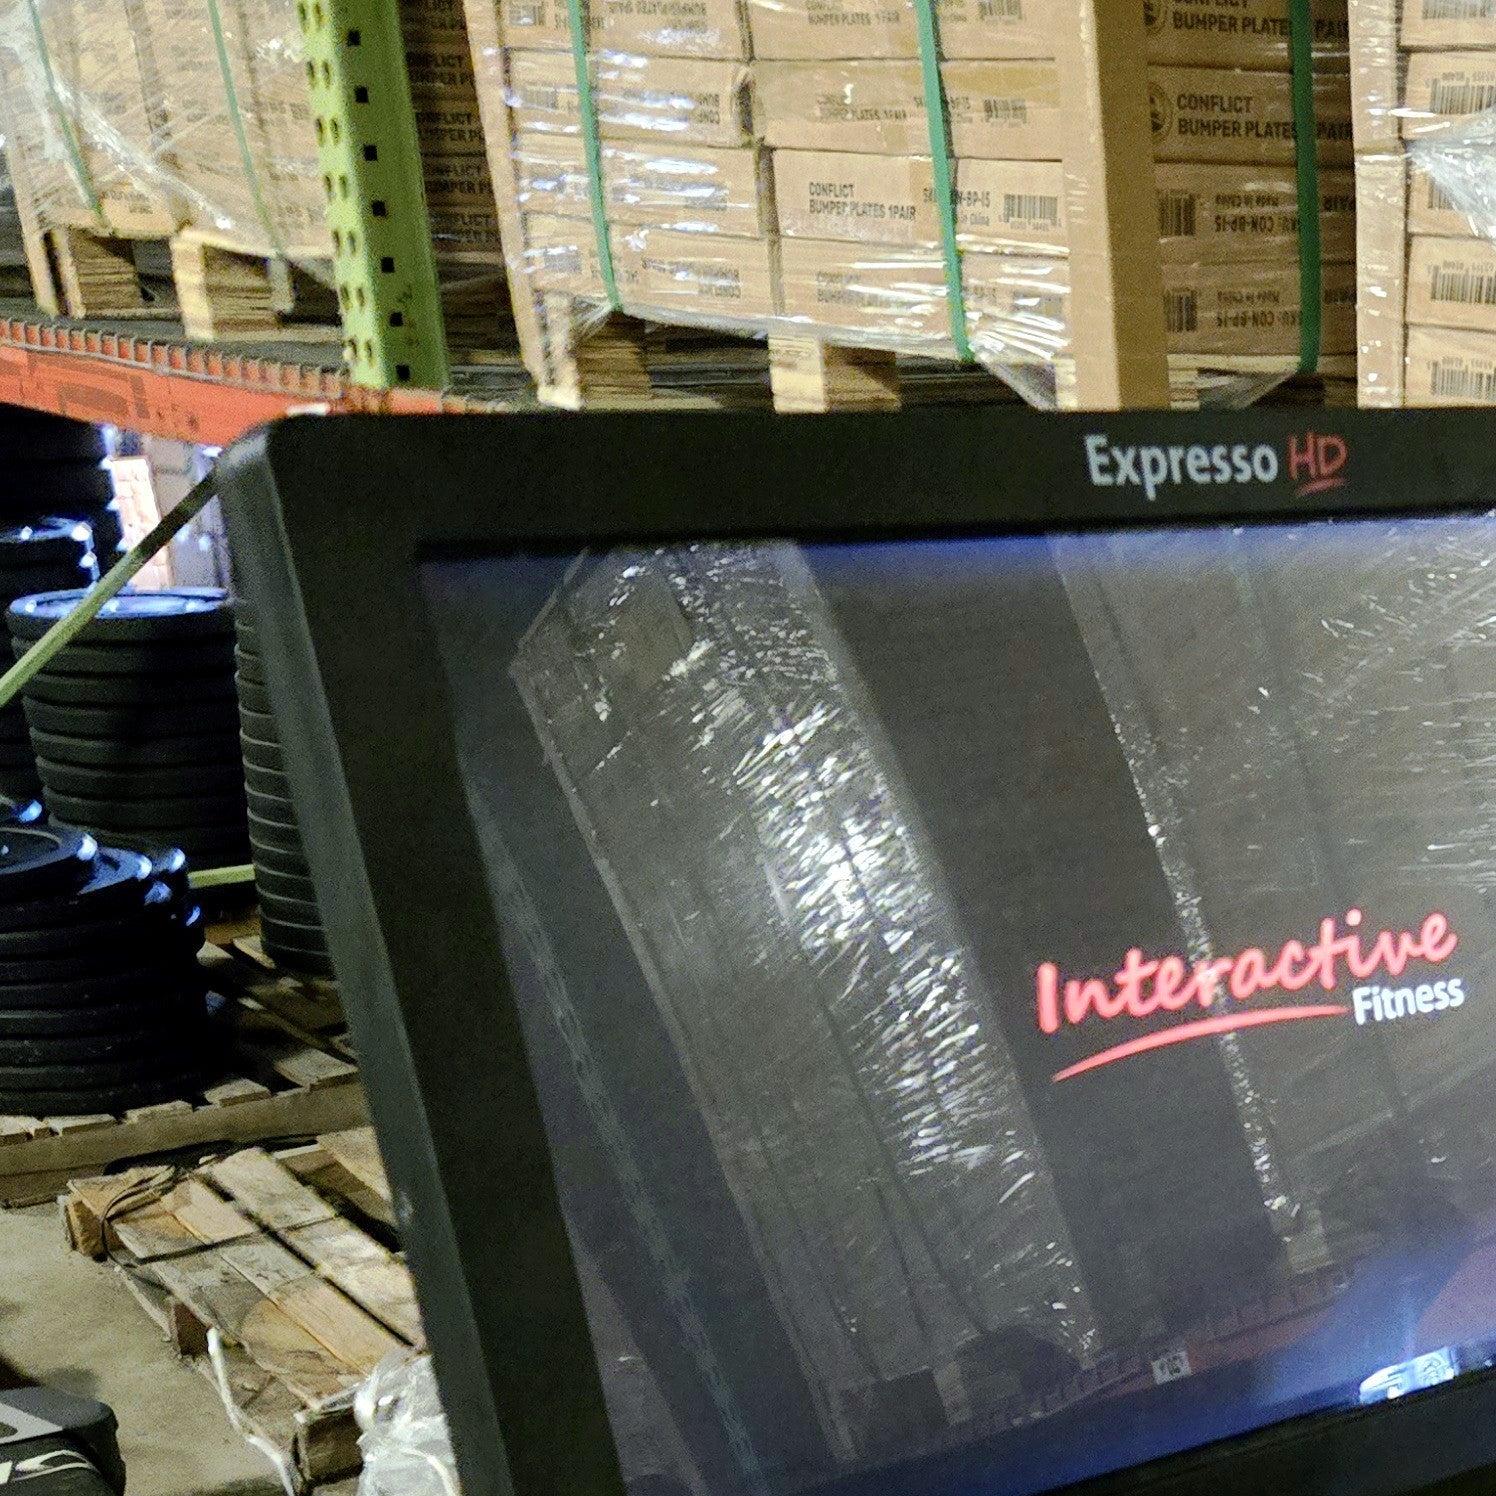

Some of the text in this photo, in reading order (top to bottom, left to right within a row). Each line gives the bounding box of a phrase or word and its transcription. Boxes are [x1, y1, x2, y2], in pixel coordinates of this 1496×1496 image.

[1173, 11, 1237, 32] BUMPER
[1176, 93, 1252, 113] CONFLICT
[1178, 118, 1243, 138] BUMPER
[809, 182, 855, 198] CONFLICT
[888, 205, 917, 220] 1PAIR
[1083, 428, 1350, 501] Expresso HD
[1036, 907, 1458, 1034] Interactive
[1351, 977, 1465, 1026] Fitness
